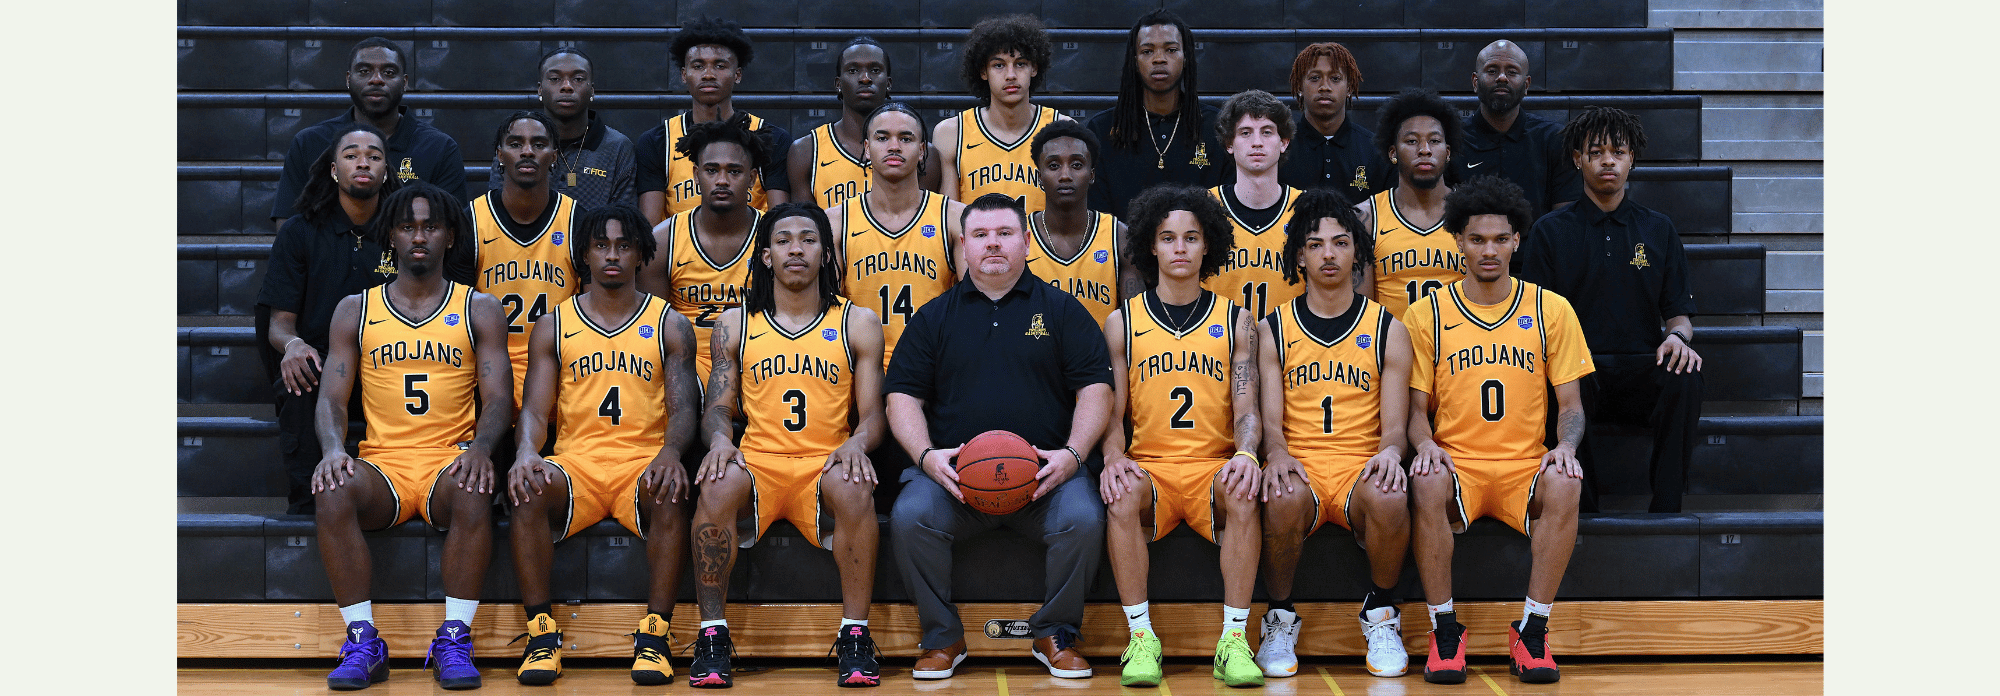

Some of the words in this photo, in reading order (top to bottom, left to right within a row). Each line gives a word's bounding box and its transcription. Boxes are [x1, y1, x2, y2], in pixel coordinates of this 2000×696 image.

[483, 260, 565, 289] TROJANS
[853, 251, 937, 281] TROJANS
[1217, 247, 1284, 276] ROJAN
[1380, 248, 1467, 275] TROJANS
[678, 283, 751, 302] TROJAN
[879, 284, 914, 325] 14
[1050, 278, 1110, 305] JANS
[1242, 281, 1268, 323] 11
[501, 293, 547, 333] 24
[369, 339, 463, 369] TROJANS
[569, 350, 653, 382] TROJANS
[750, 353, 840, 385] TROJANS
[1138, 350, 1224, 382] TROJANS
[1446, 343, 1535, 376] TROJANS
[1287, 360, 1371, 392] TROJANS
[403, 373, 430, 416] 5
[598, 385, 622, 426] 4
[782, 389, 807, 432] 3
[1169, 386, 1195, 429] 2
[1480, 378, 1506, 422] 0
[1320, 395, 1333, 434] 1
